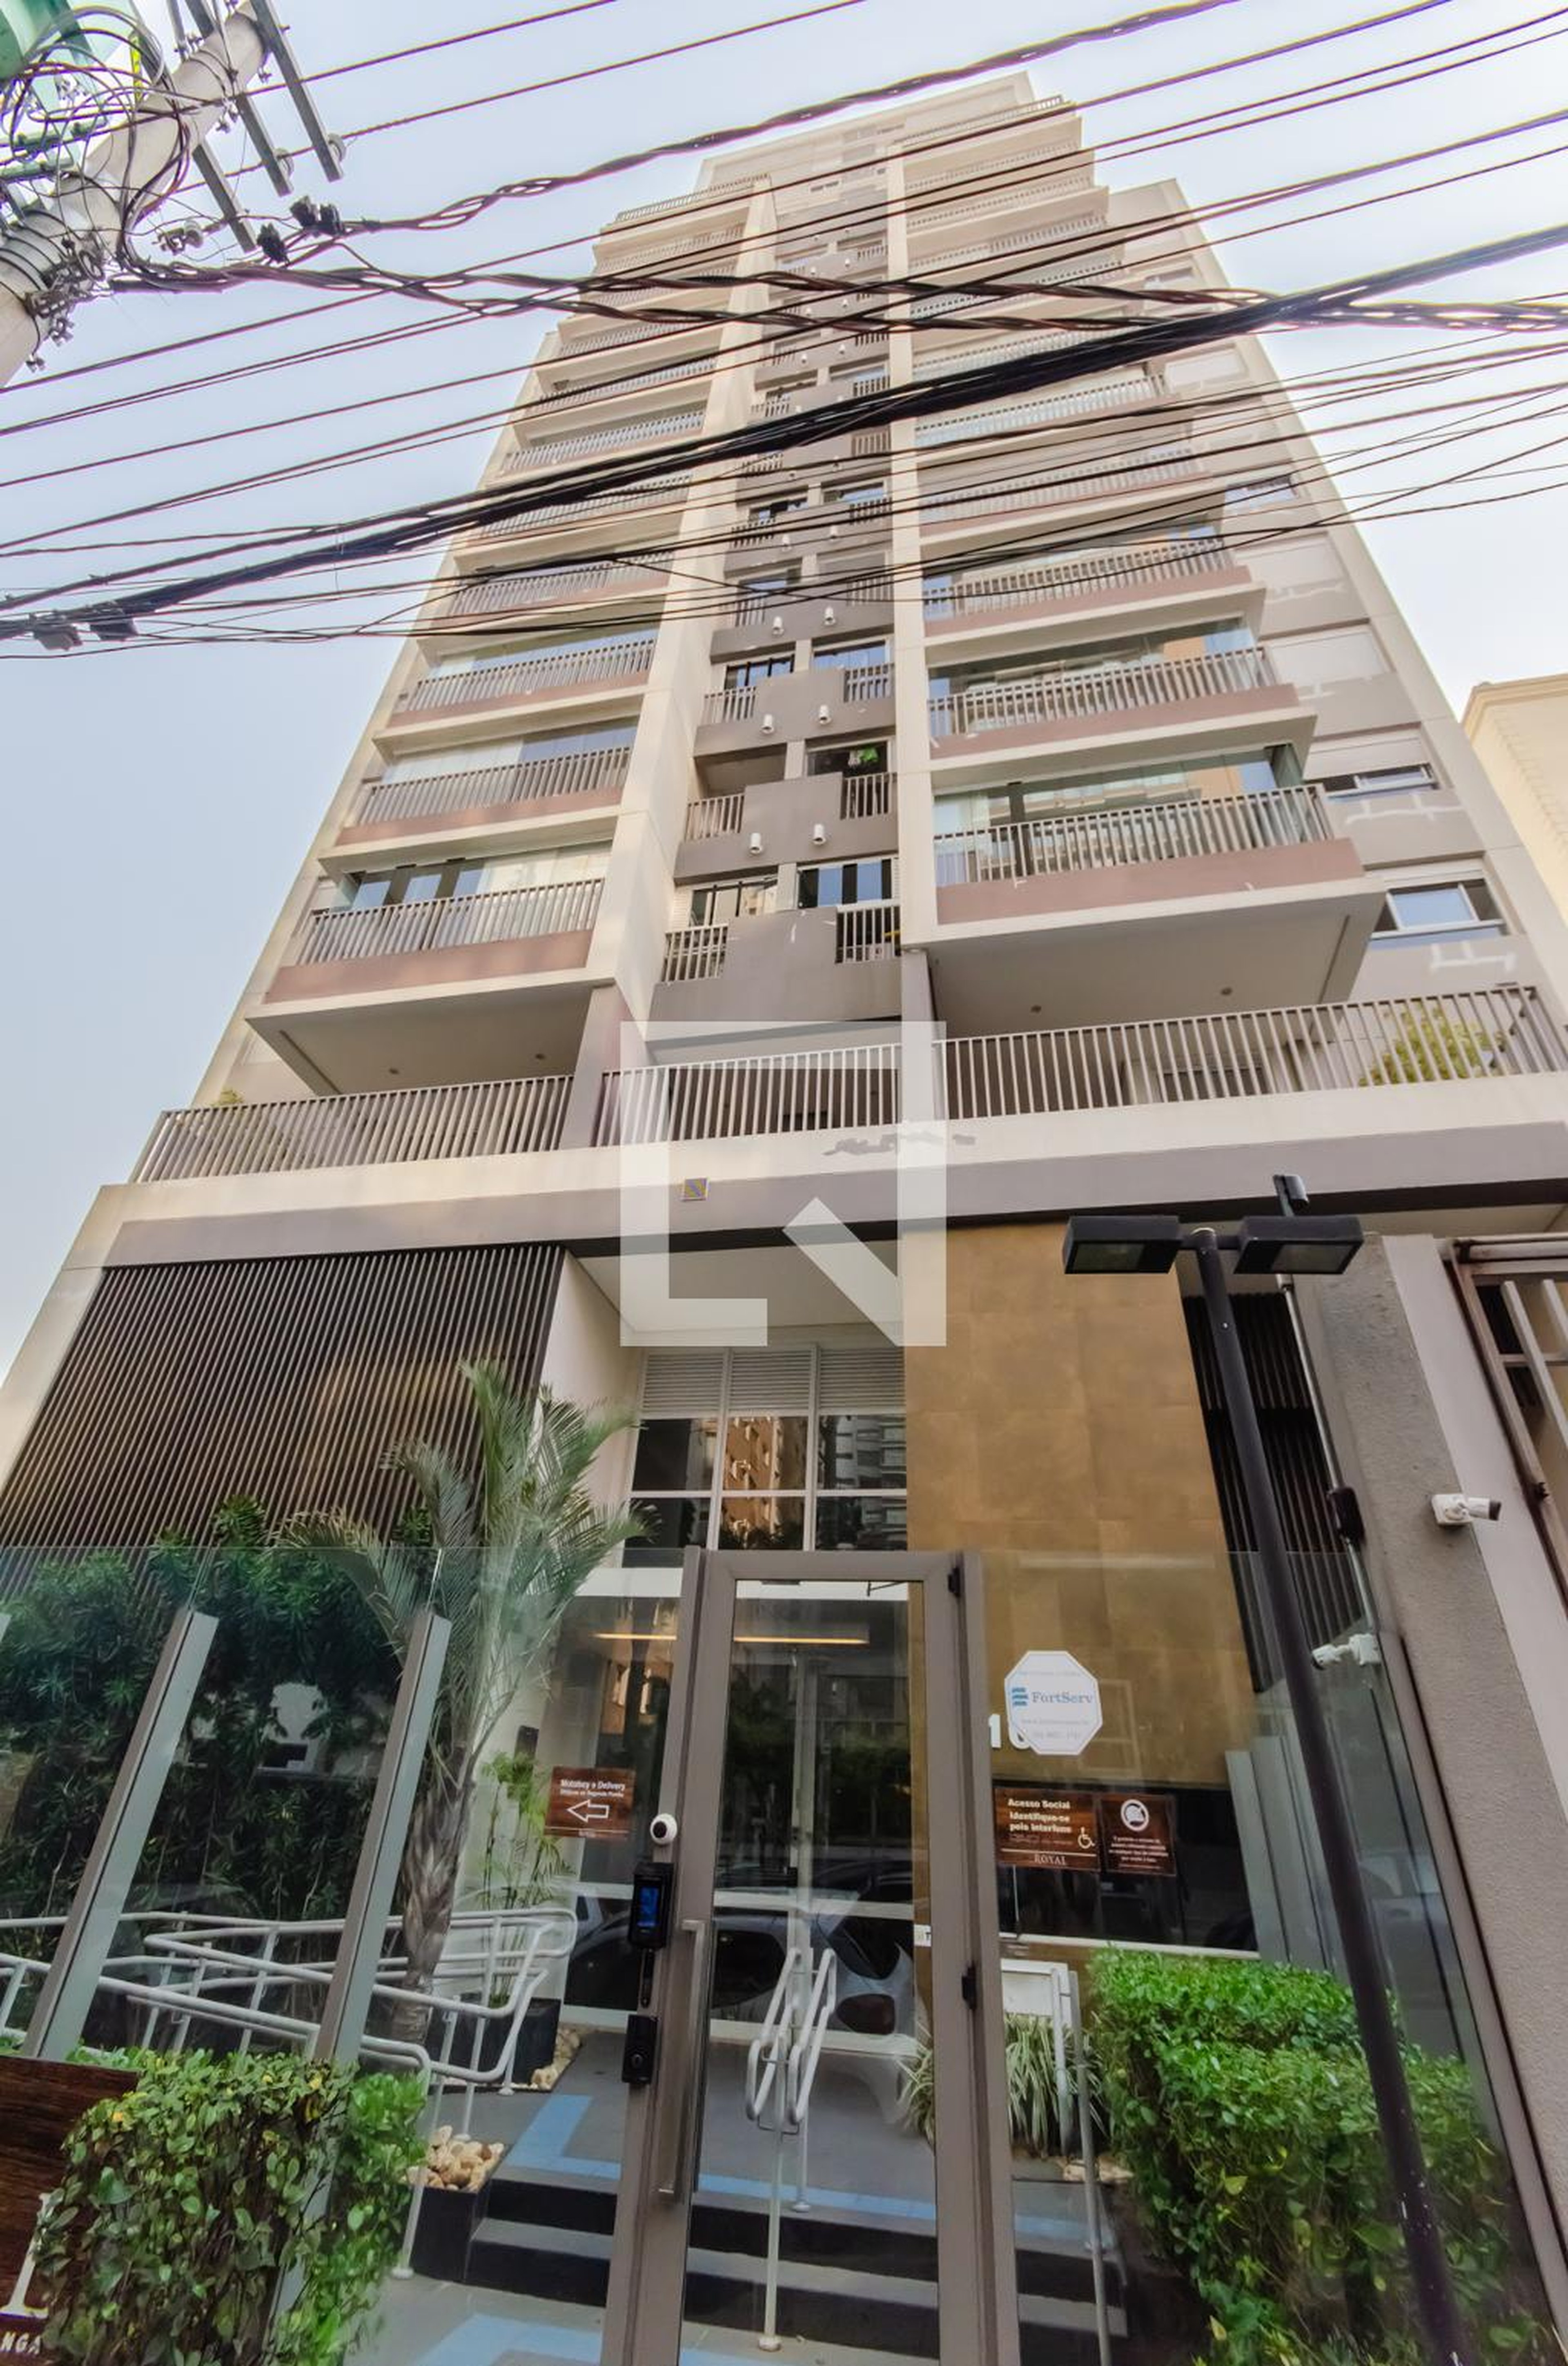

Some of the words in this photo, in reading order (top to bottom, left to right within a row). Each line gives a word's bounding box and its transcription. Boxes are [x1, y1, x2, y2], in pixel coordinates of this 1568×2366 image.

[1031, 1691, 1092, 1704] FortServ
[597, 1781, 626, 1791] Delivery
[1008, 1798, 1040, 1808] Acesso
[1042, 1800, 1070, 1809] Social
[1009, 1811, 1070, 1823] Identifique-se
[1009, 1822, 1029, 1832] pelo
[1034, 1854, 1067, 1865] ROYAL
